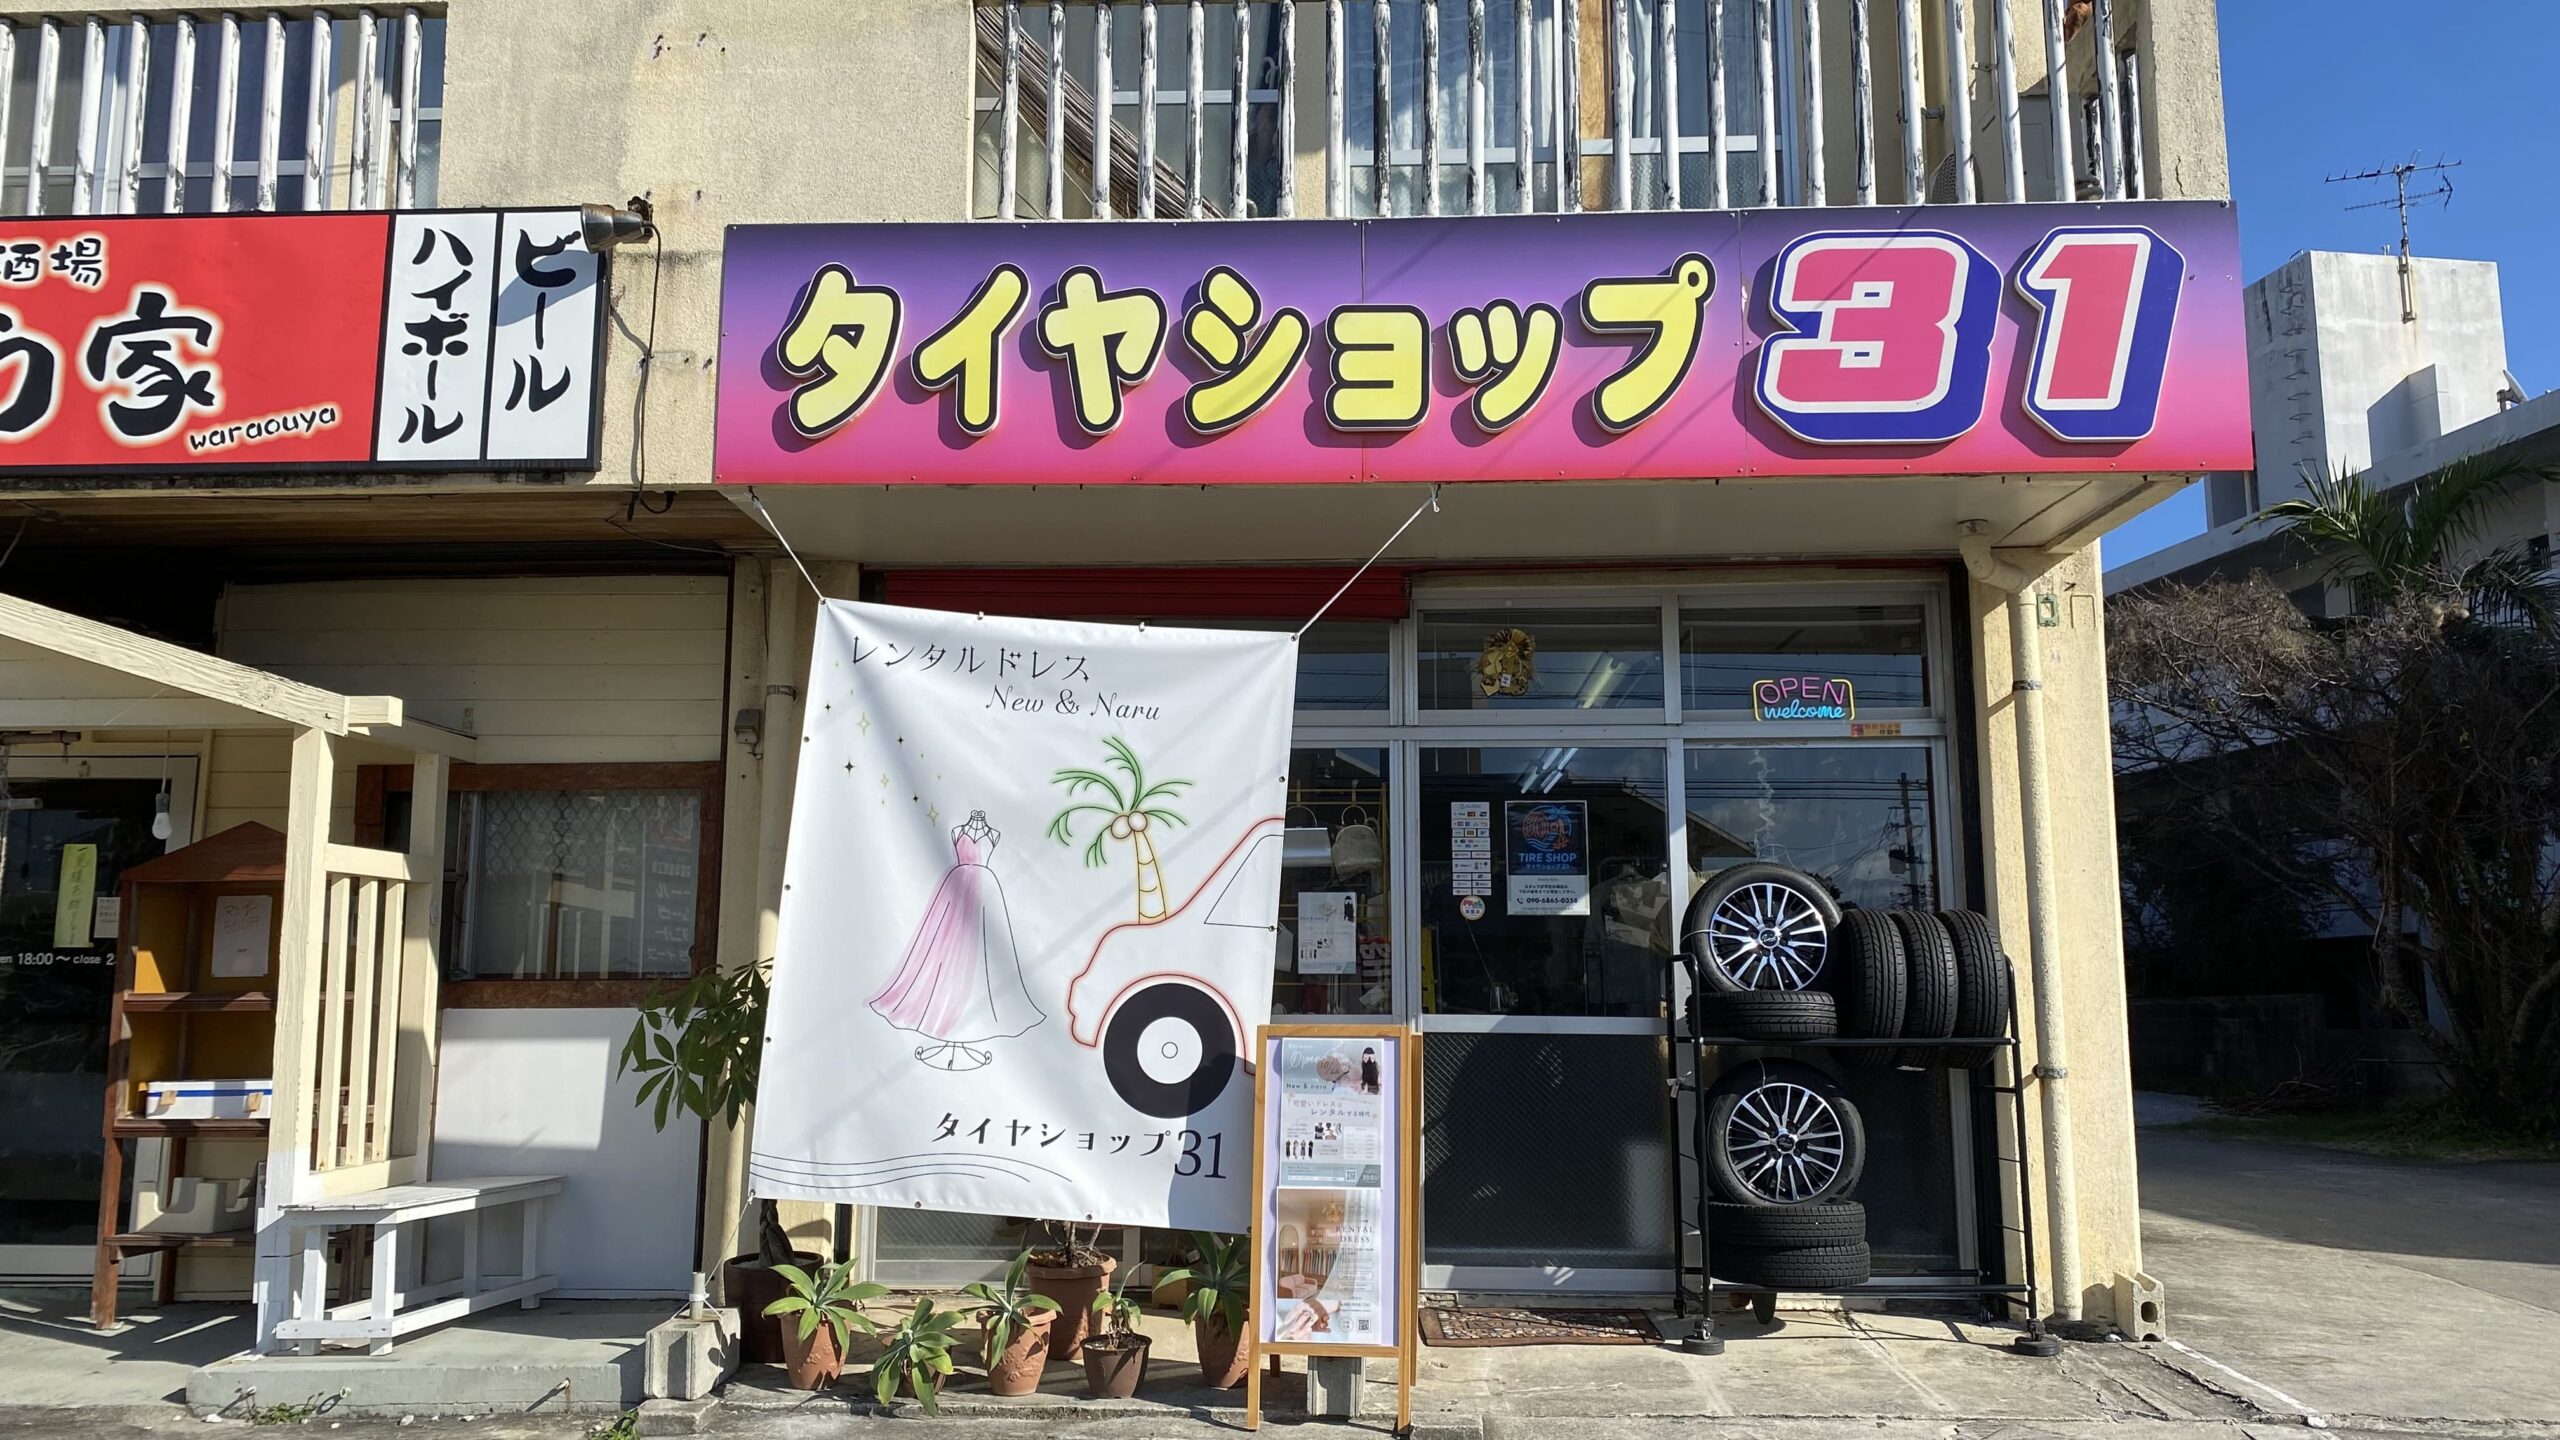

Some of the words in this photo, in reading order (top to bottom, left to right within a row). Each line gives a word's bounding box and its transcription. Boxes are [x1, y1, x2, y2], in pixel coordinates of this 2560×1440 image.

[398, 228, 472, 444] ハイボール
[505, 229, 581, 412] ビール
[189, 407, 336, 450] waraouya
[852, 635, 1090, 683] レンタルドレス
[985, 684, 1044, 713] New
[1054, 688, 1080, 715] &
[1090, 691, 1161, 721] Naru
[1759, 676, 1846, 704] OPEN
[1764, 699, 1846, 719] welcome
[1518, 853, 1543, 863] TIRE
[1545, 853, 1577, 863] SHOP
[17, 952, 54, 965] 18:00
[73, 954, 101, 964] close
[932, 1112, 1227, 1180] タイヤショップ31
